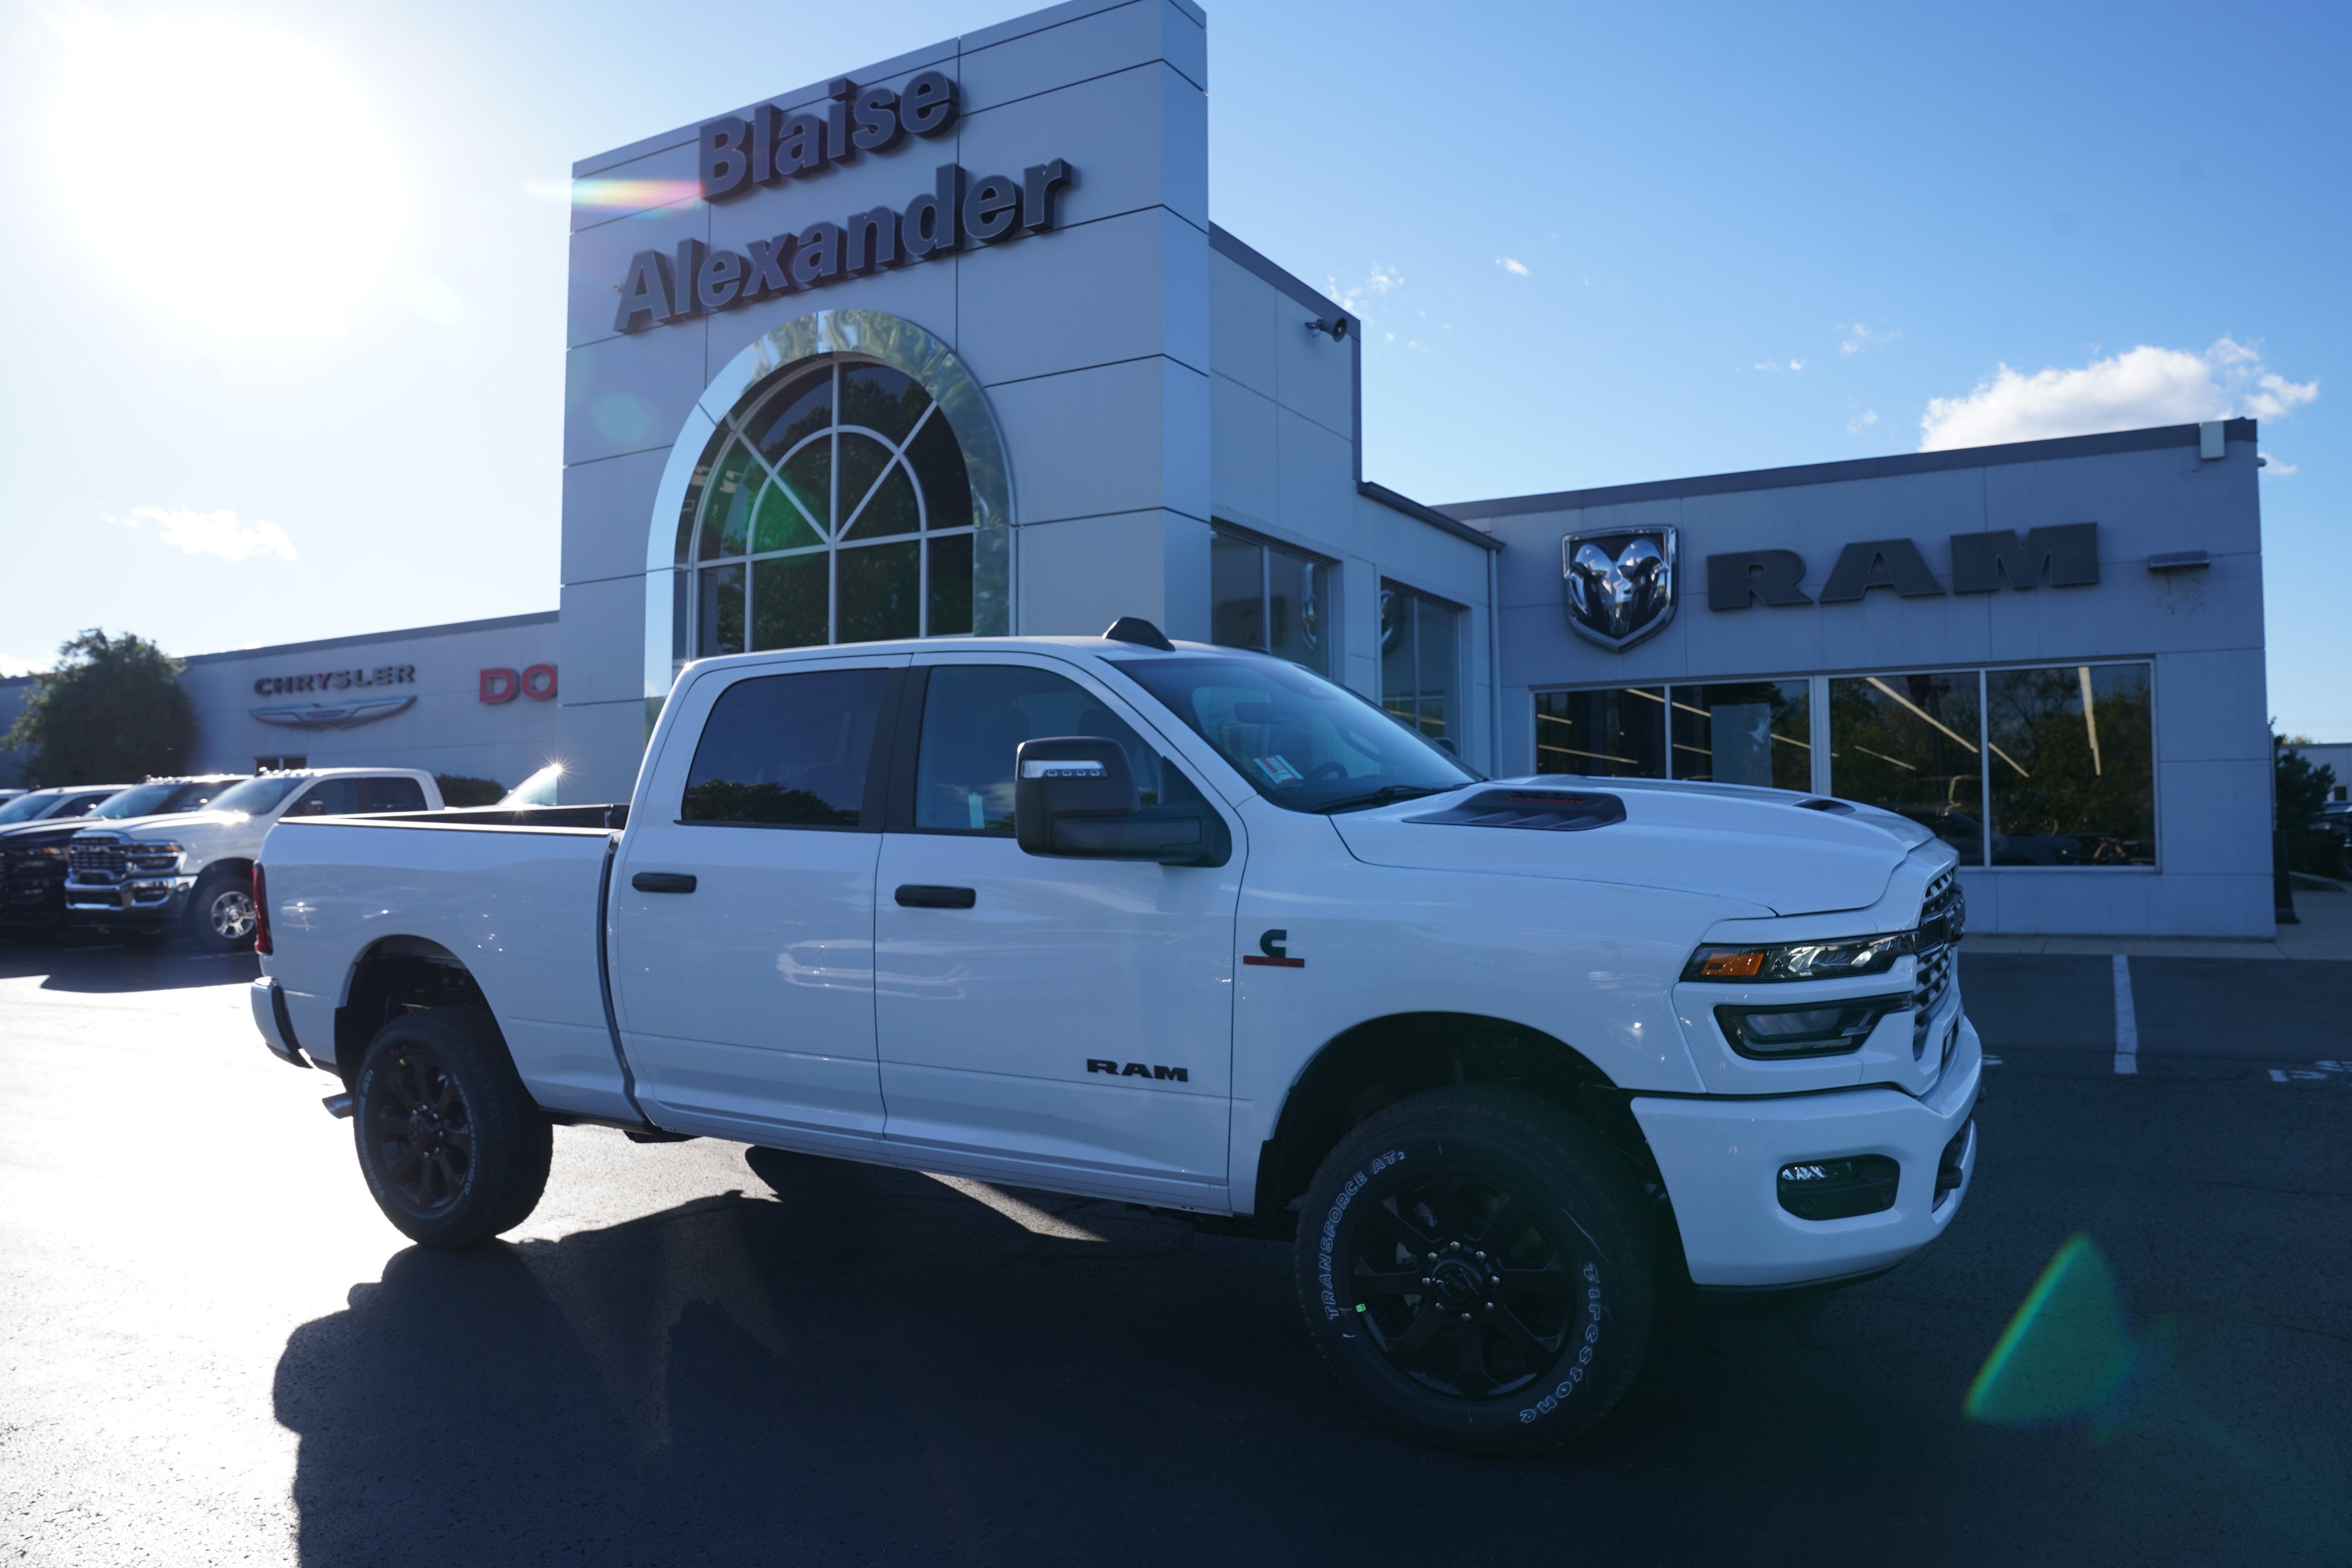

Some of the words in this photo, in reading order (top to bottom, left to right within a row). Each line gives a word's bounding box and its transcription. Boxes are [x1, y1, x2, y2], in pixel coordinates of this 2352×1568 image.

[699, 70, 959, 203] Blaise
[613, 158, 1071, 334] Alexander
[1707, 522, 2100, 610] RAM
[254, 664, 416, 697] CHRYSLER
[1087, 1058, 1188, 1082] RAM
[1319, 1171, 1368, 1319] TRANSFORCE
